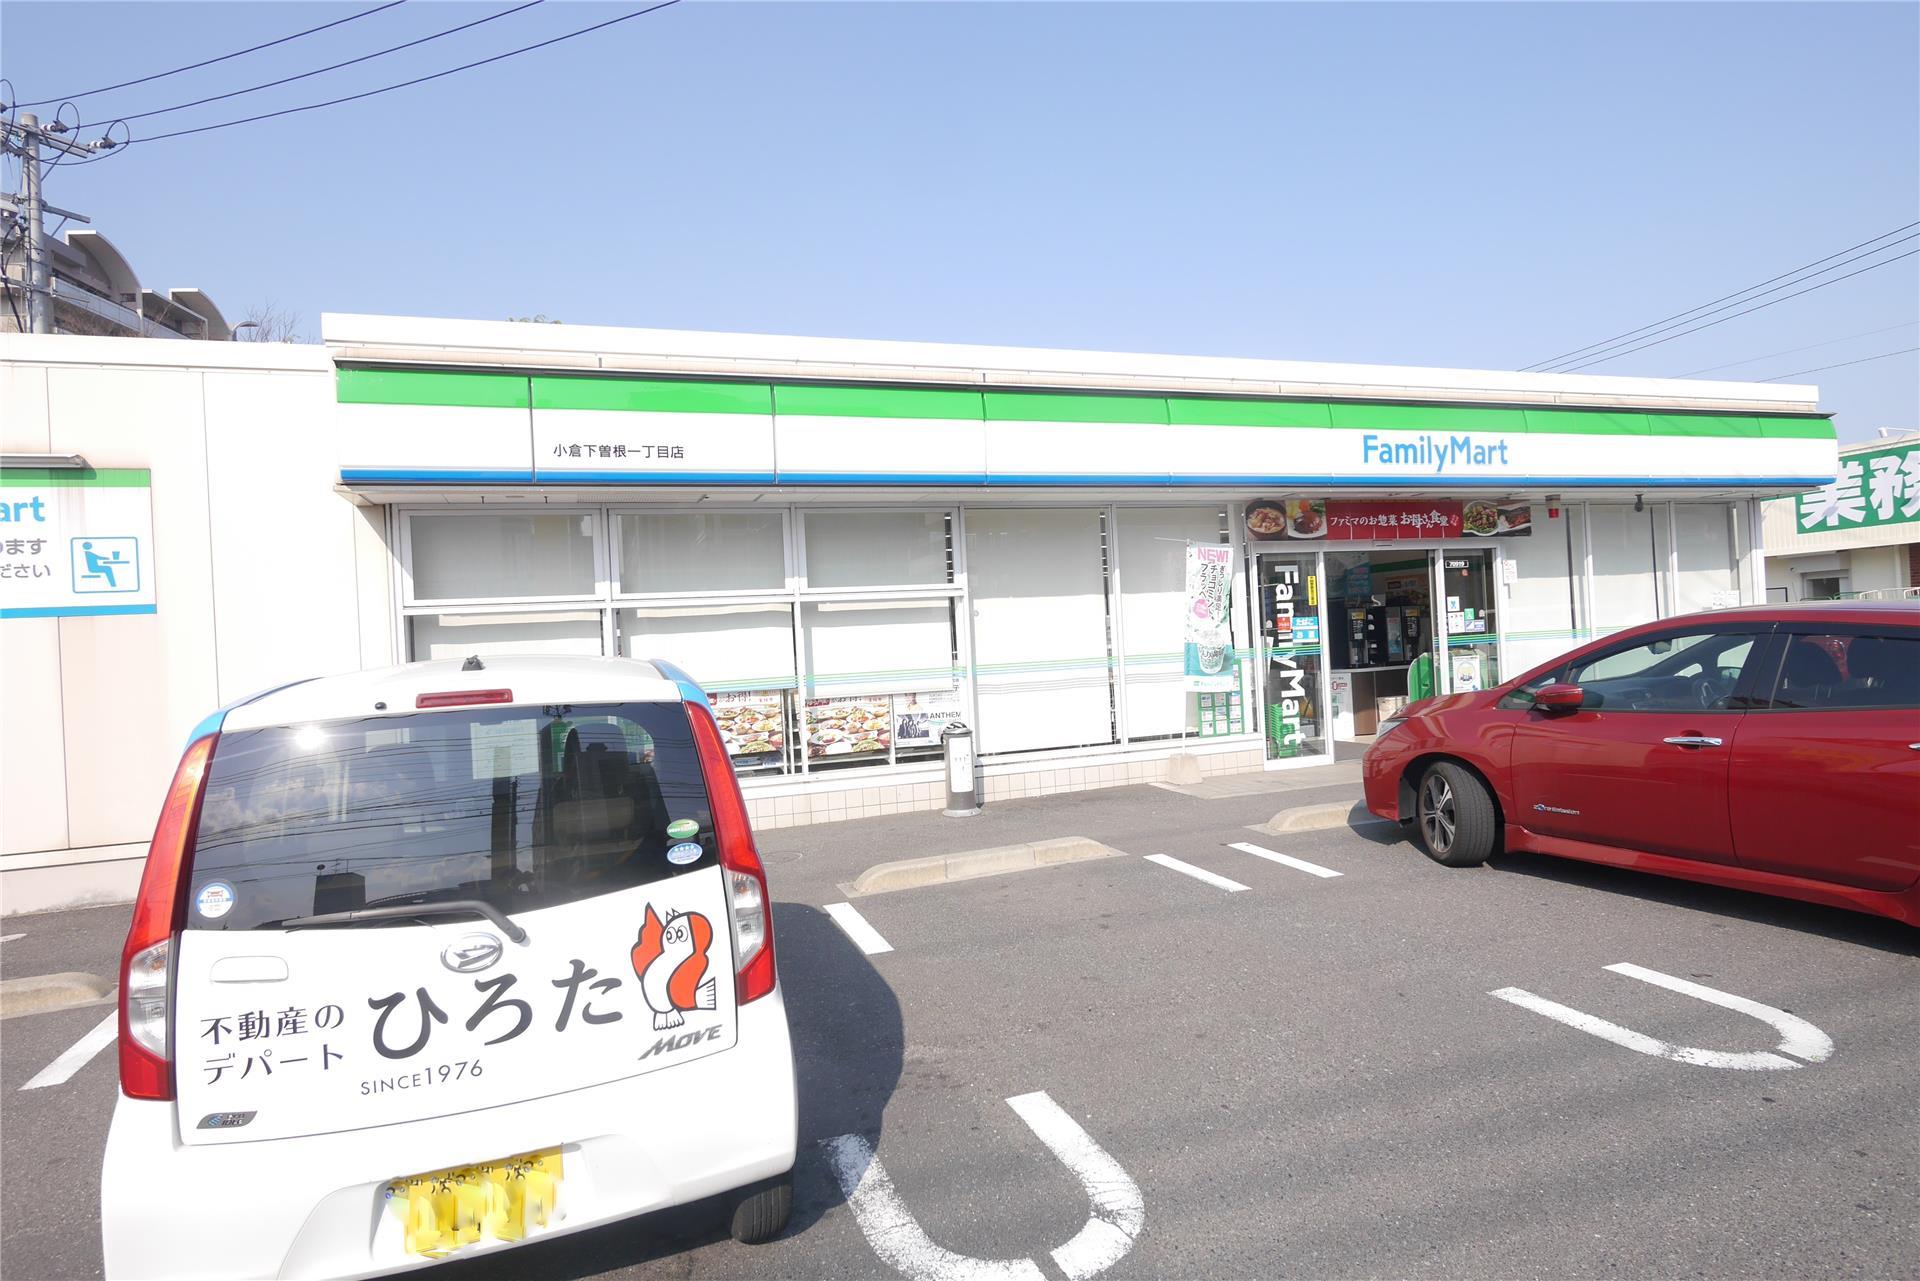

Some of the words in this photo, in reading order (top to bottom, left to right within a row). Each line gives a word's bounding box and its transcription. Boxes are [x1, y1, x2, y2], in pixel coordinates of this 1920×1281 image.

[553, 443, 684, 459] 小倉下曽根一丁目店
[1363, 434, 1508, 472] FamilyMart
[1197, 546, 1229, 563] NEW!
[200, 1004, 345, 1045] 不動産の
[368, 958, 623, 1060] ひろた
[638, 1024, 722, 1060] MOVE
[203, 1043, 343, 1086] デパート
